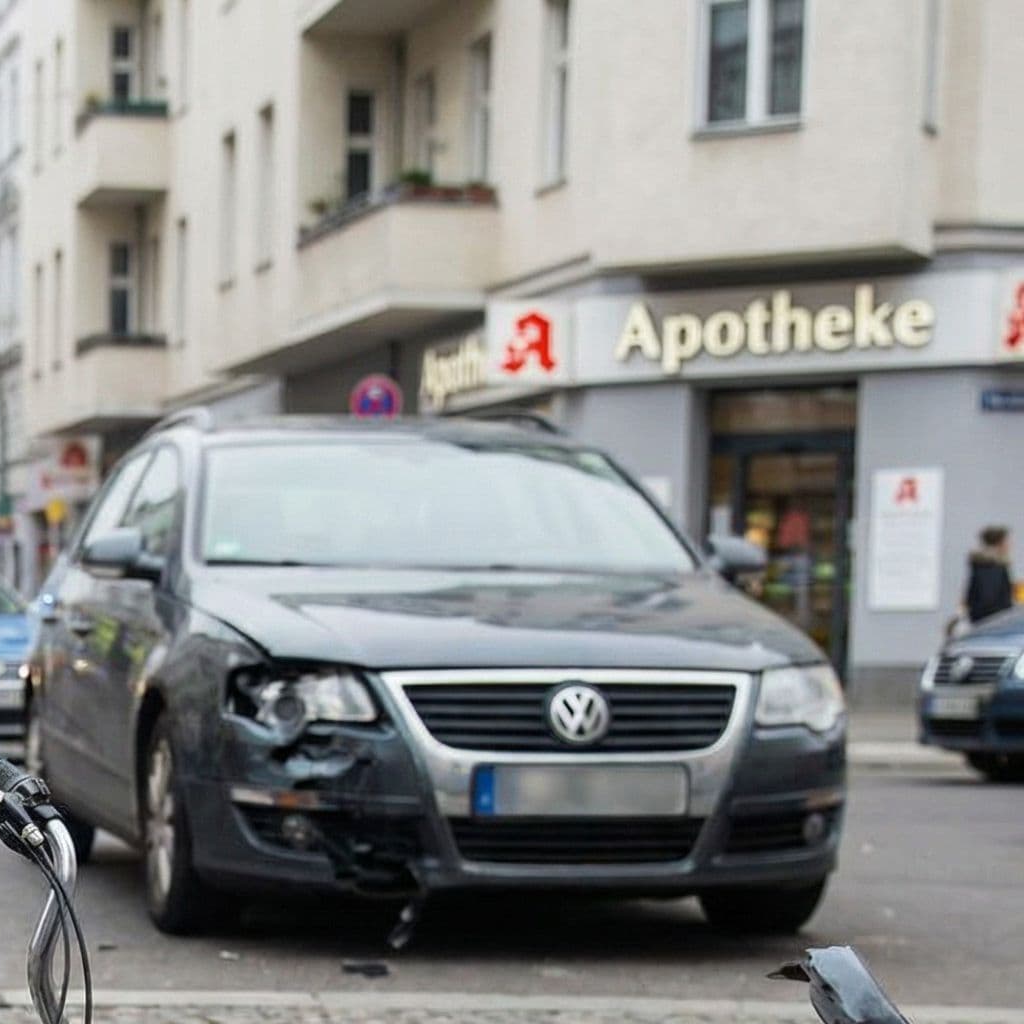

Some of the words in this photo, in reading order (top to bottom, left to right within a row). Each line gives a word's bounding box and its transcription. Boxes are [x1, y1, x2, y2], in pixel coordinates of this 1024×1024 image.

[503, 313, 555, 371] A
[614, 286, 934, 373] Apotheke
[550, 686, 608, 742] VW
